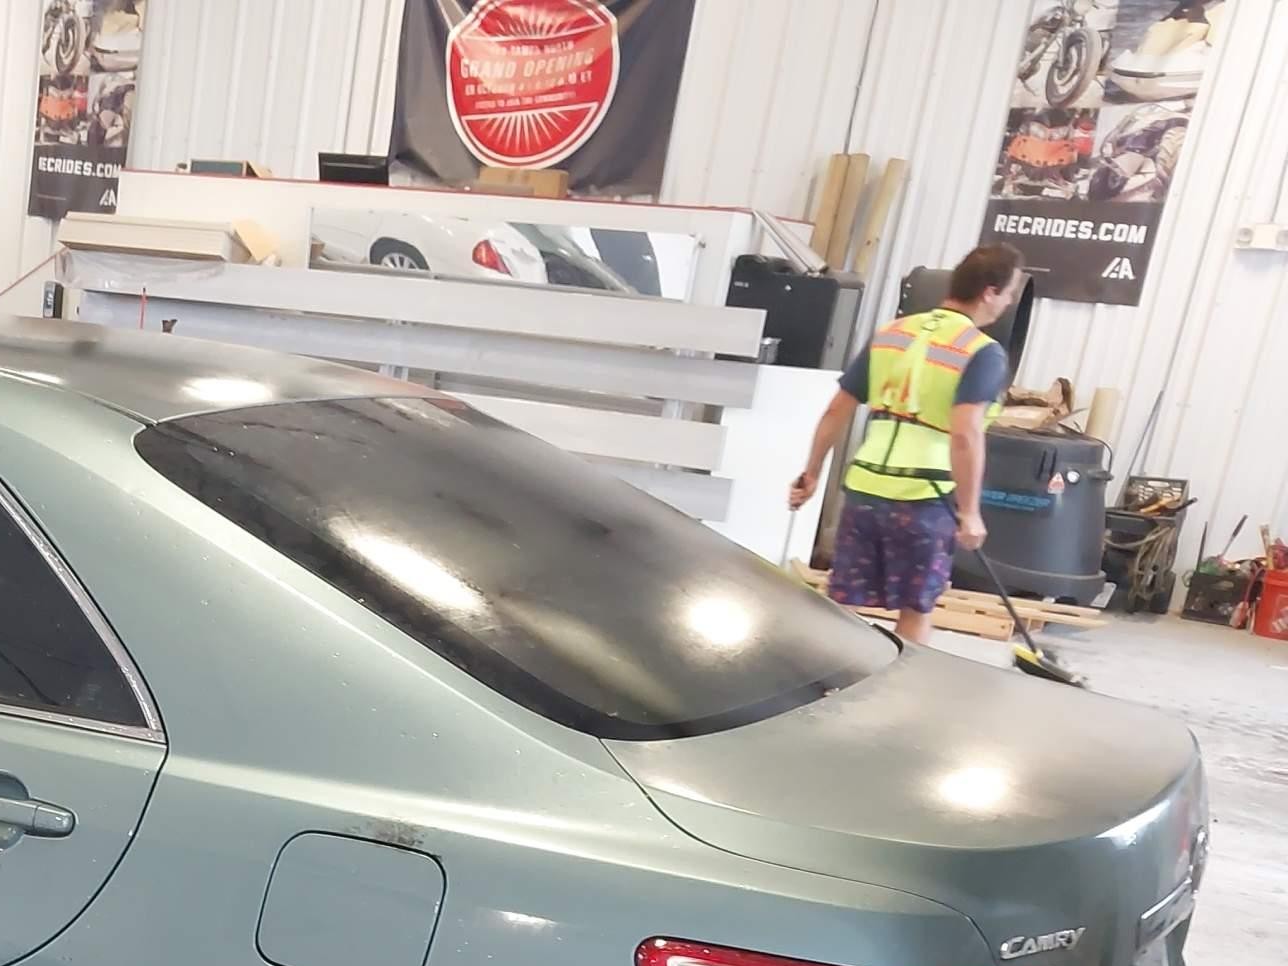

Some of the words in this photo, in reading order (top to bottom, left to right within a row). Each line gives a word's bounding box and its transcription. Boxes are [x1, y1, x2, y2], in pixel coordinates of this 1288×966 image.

[461, 57, 517, 79] GRAND
[523, 48, 595, 78] OPENING
[38, 156, 121, 178] ECRIDES.COM
[994, 214, 1147, 244] RECRIDES.COM
[1000, 927, 1087, 960] CAMRY
